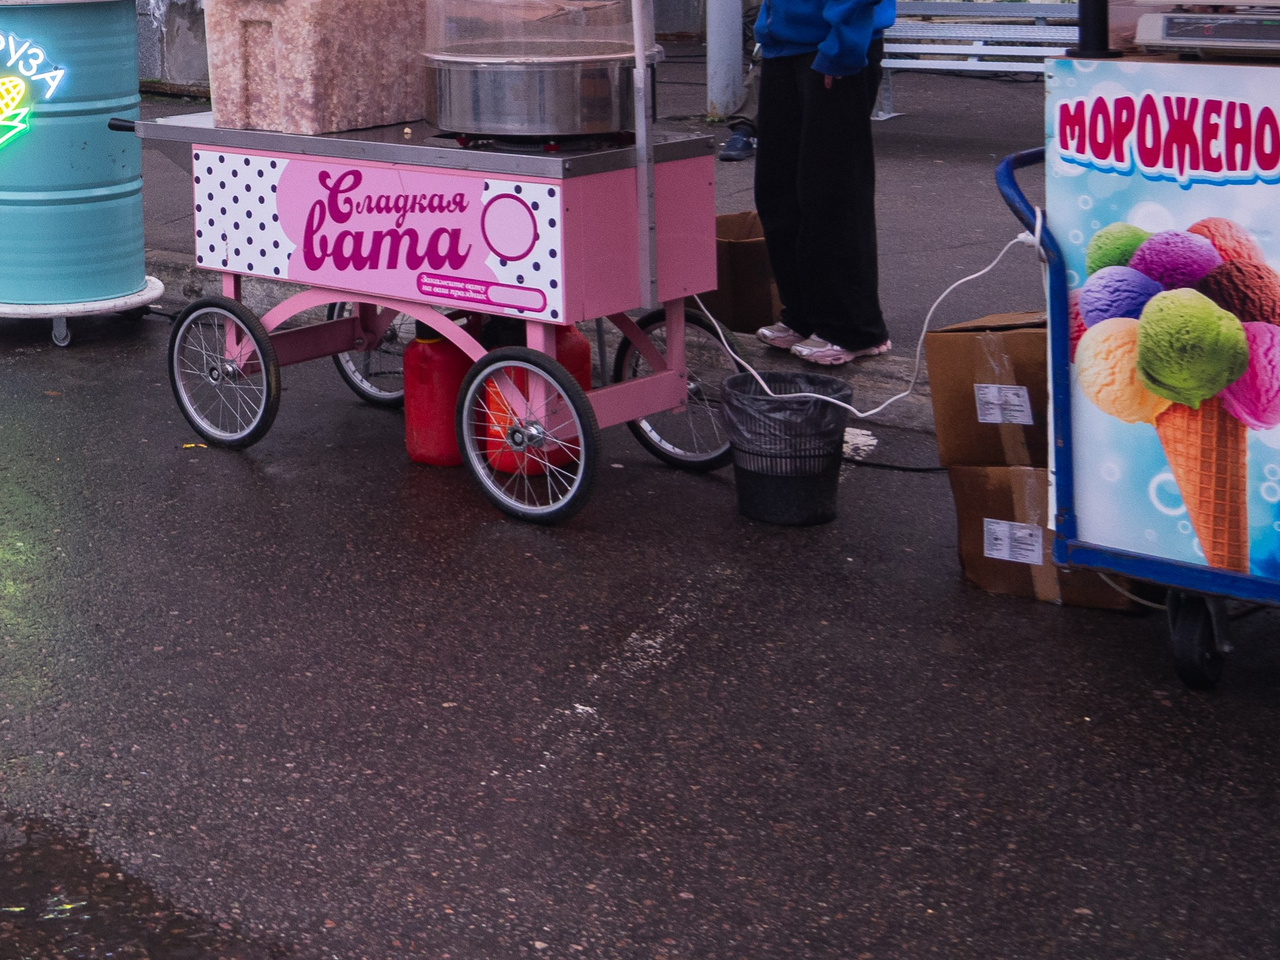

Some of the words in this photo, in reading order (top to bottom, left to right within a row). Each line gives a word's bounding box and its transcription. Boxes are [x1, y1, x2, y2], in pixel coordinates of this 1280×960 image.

[1059, 93, 1280, 177] МОРОЖЕНО
[302, 198, 473, 272] вата
[317, 168, 470, 230] Сладкая
